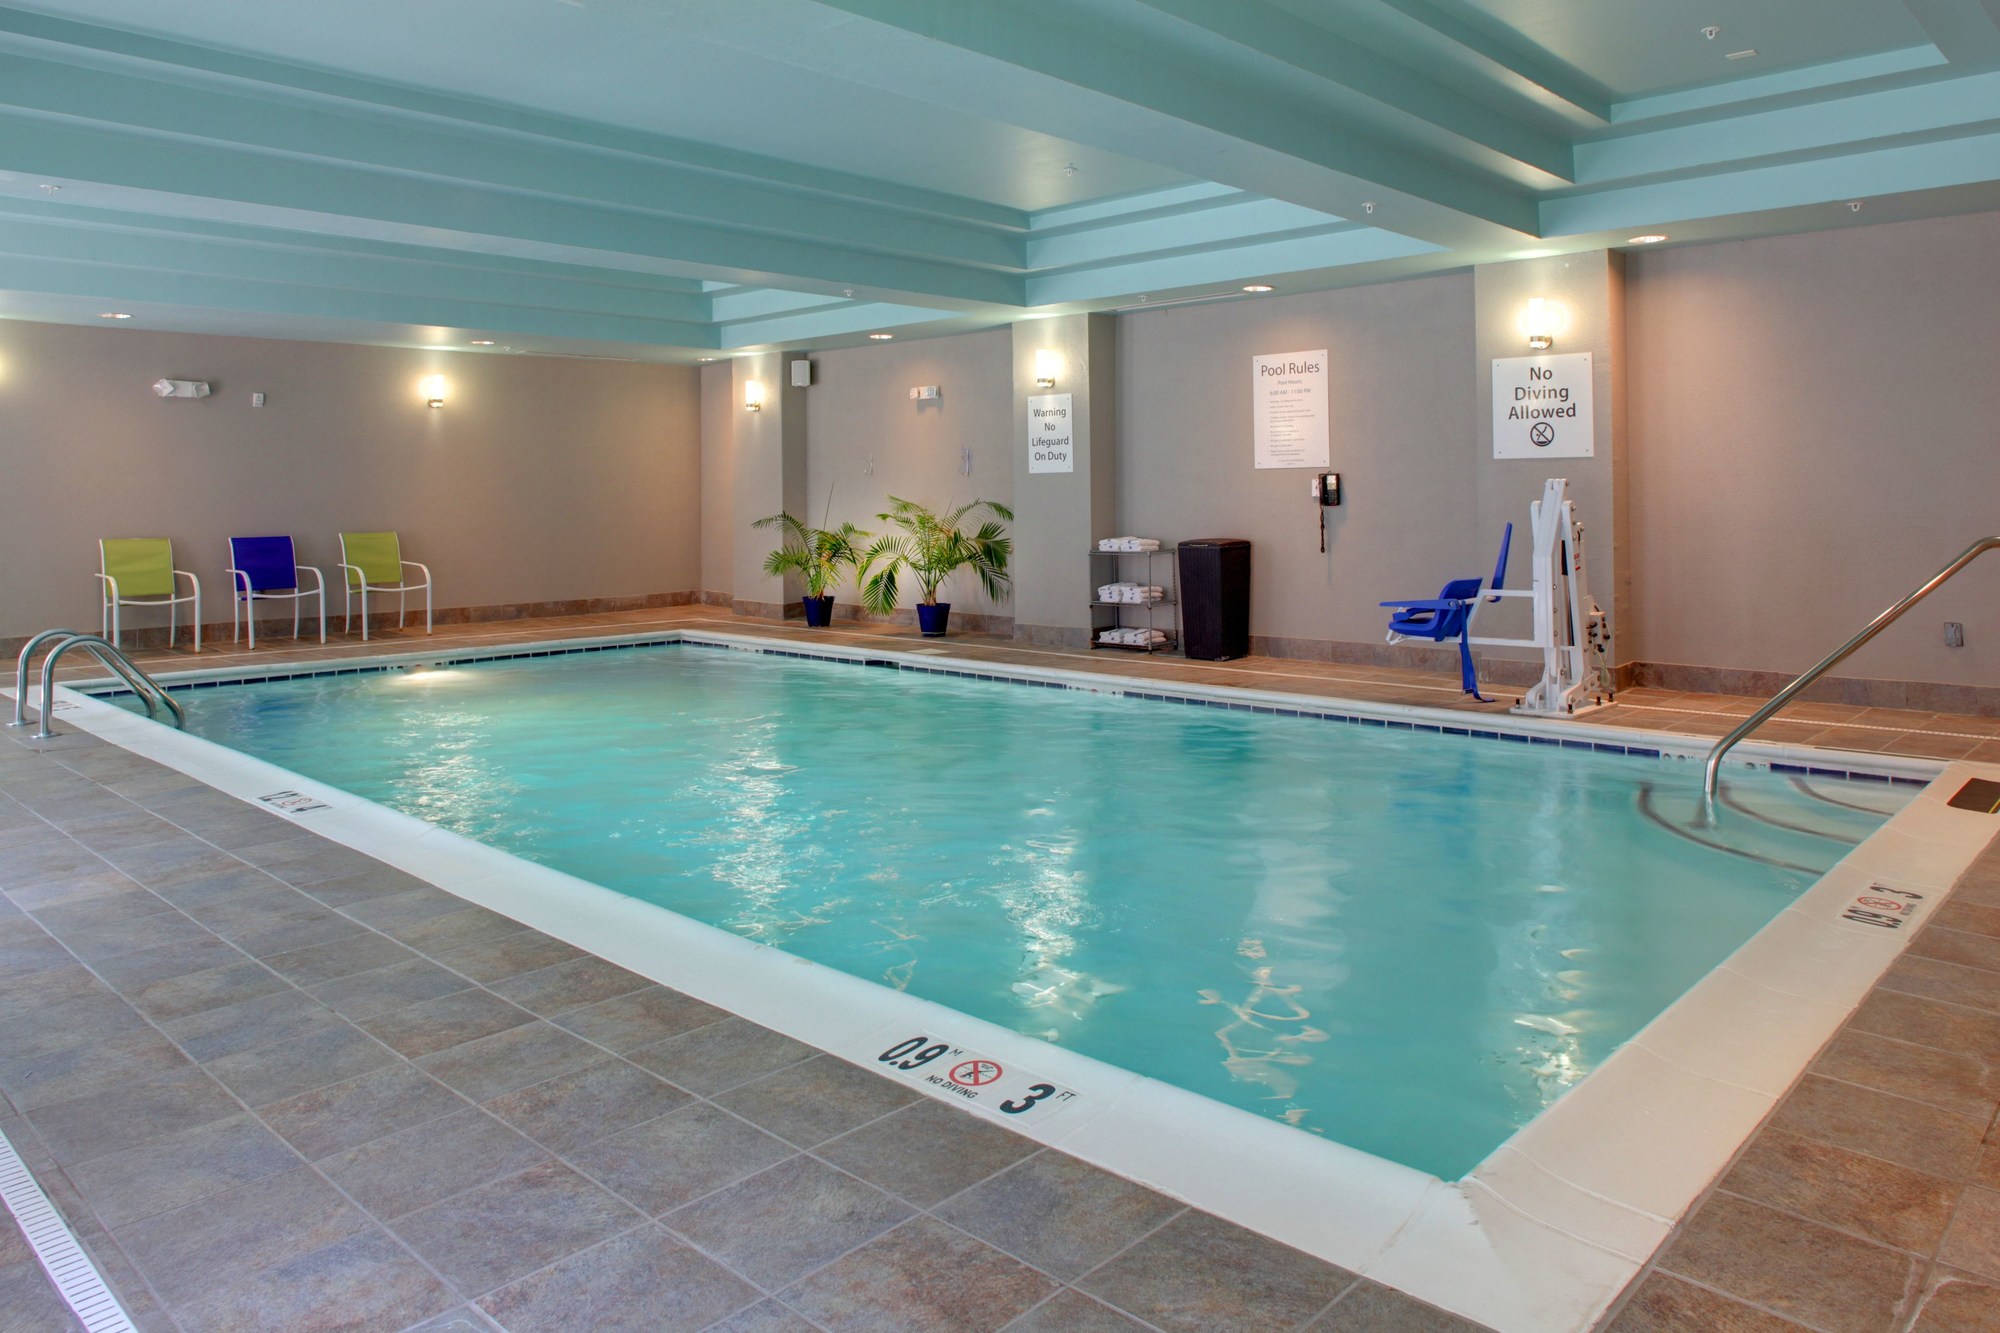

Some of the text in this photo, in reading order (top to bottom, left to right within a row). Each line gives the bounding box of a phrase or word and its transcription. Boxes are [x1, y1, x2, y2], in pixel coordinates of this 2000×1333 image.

[1261, 361, 1320, 376] Pool Rules
[1530, 367, 1553, 381] No
[1514, 385, 1569, 402] Diving
[1033, 408, 1067, 418] Warning
[1508, 402, 1576, 420] Allowed
[1044, 422, 1056, 431] No
[1031, 436, 1069, 448] Lifeguard
[1034, 451, 1068, 462] On Duty
[1869, 886, 1924, 900] 3
[878, 1036, 964, 1070] 0.9 M
[925, 1074, 979, 1099] NO DIVING
[999, 1083, 1076, 1114] 3 FT
